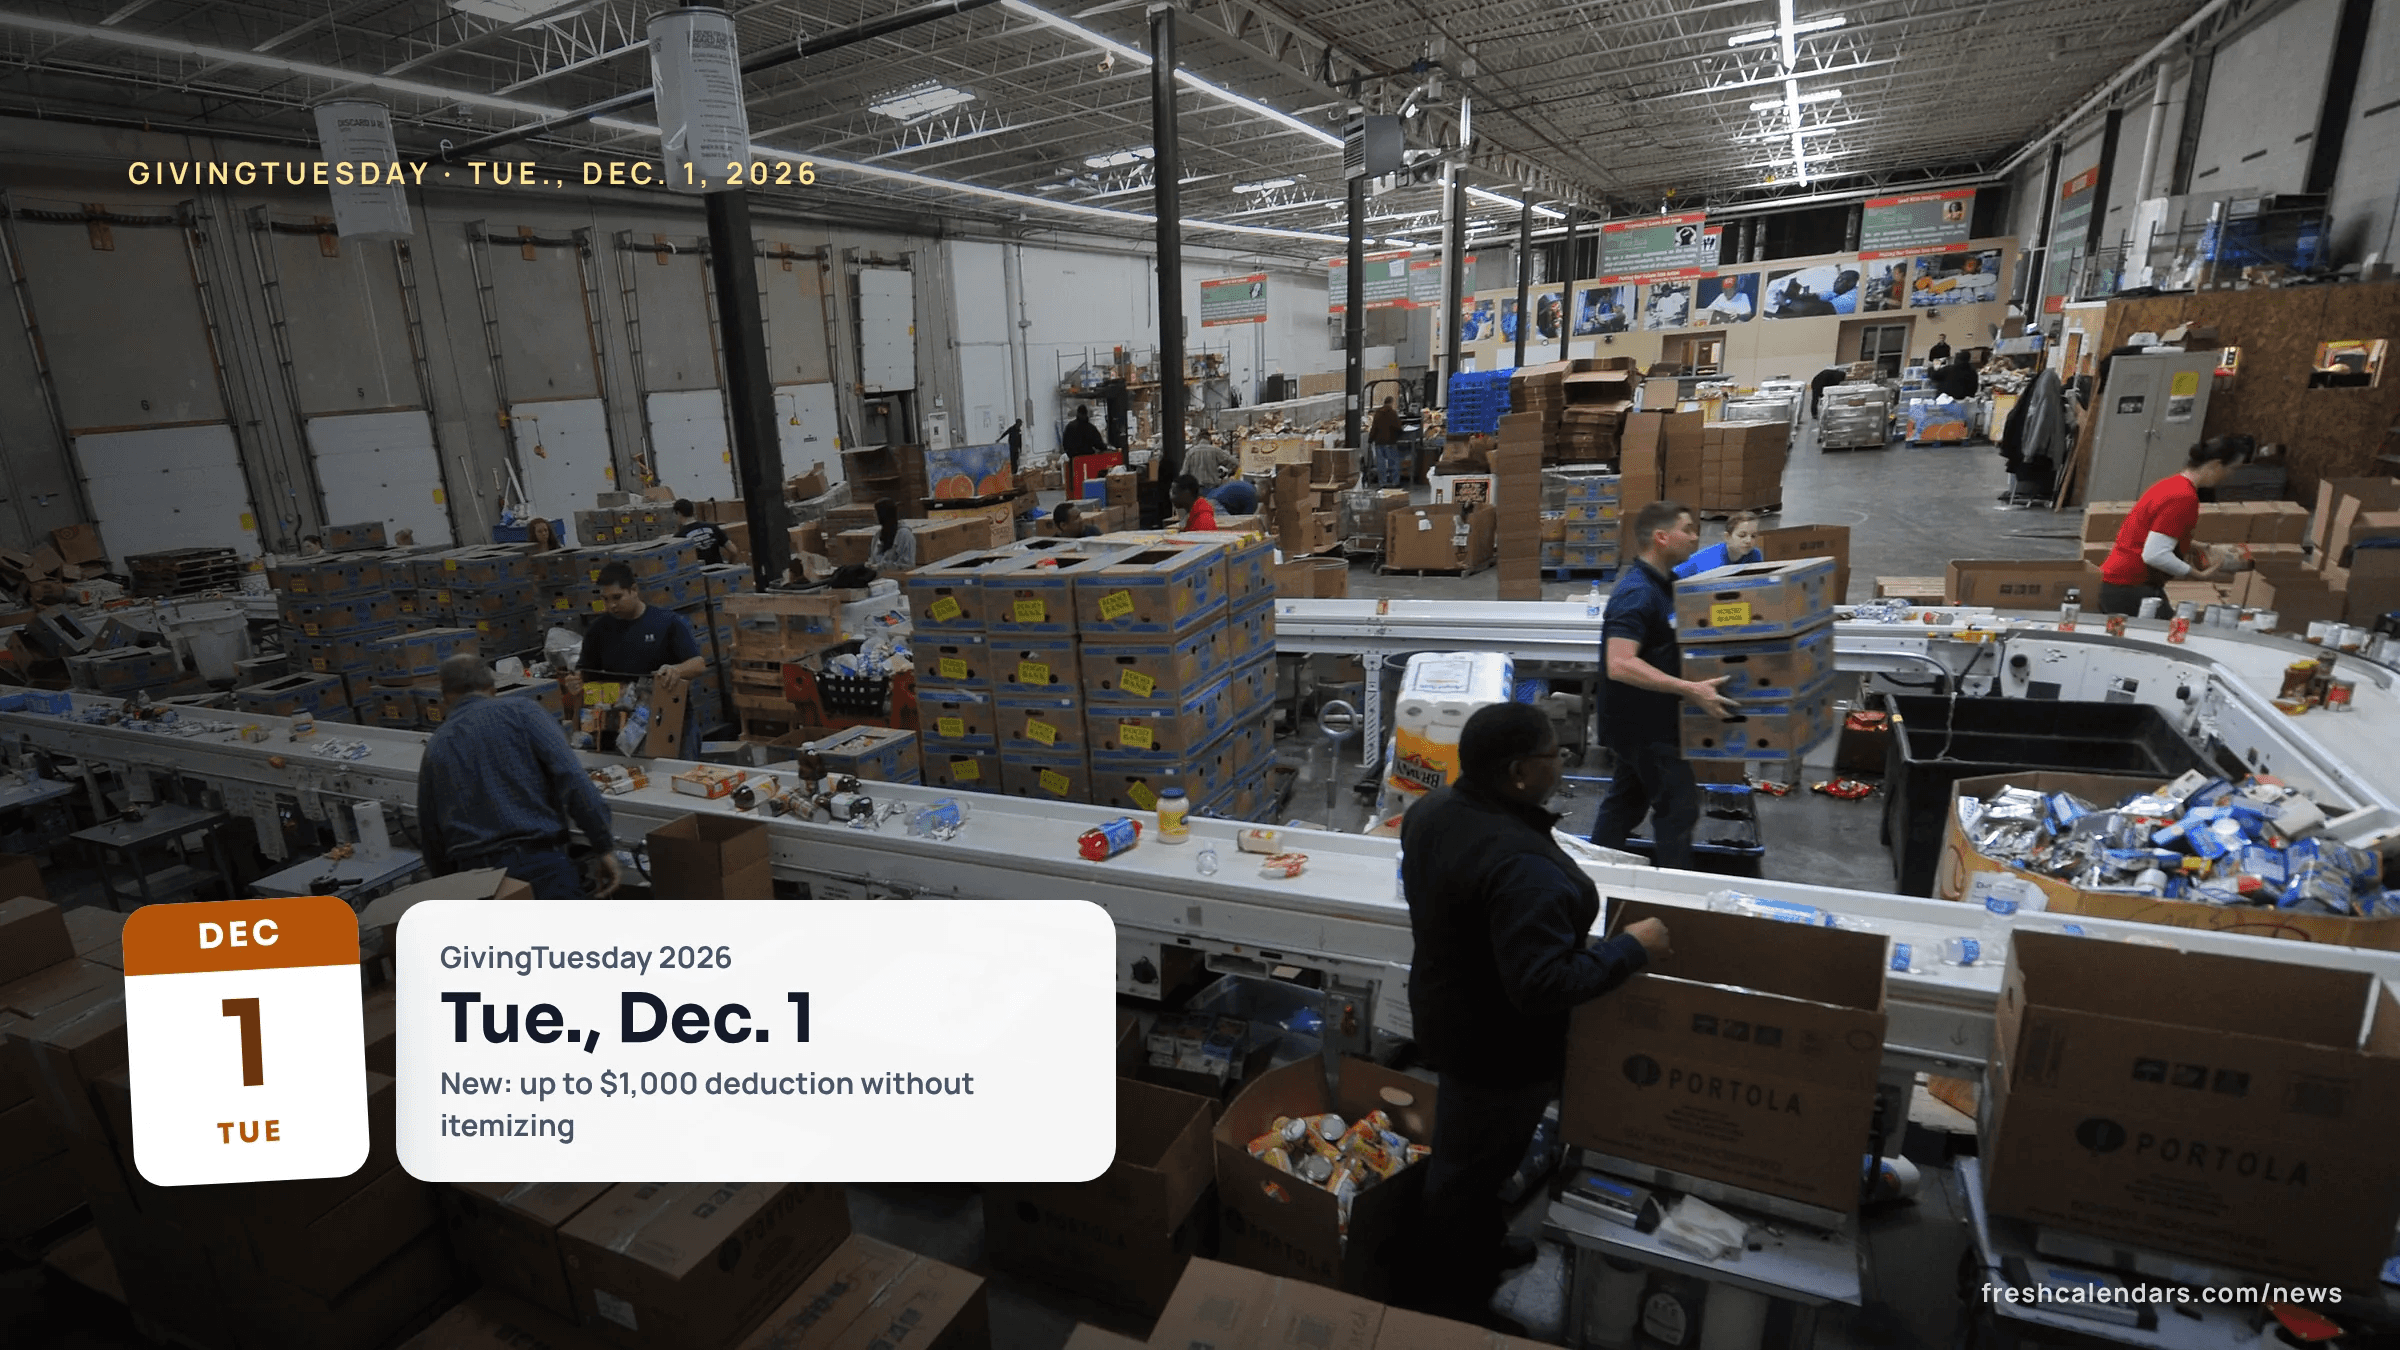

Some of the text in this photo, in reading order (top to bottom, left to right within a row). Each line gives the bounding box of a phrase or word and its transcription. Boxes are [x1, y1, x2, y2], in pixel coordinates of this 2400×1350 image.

[357, 387, 365, 398] 5
[1669, 1067, 1802, 1115] PORTOLA
[2135, 1132, 2310, 1187] PORTOLA
